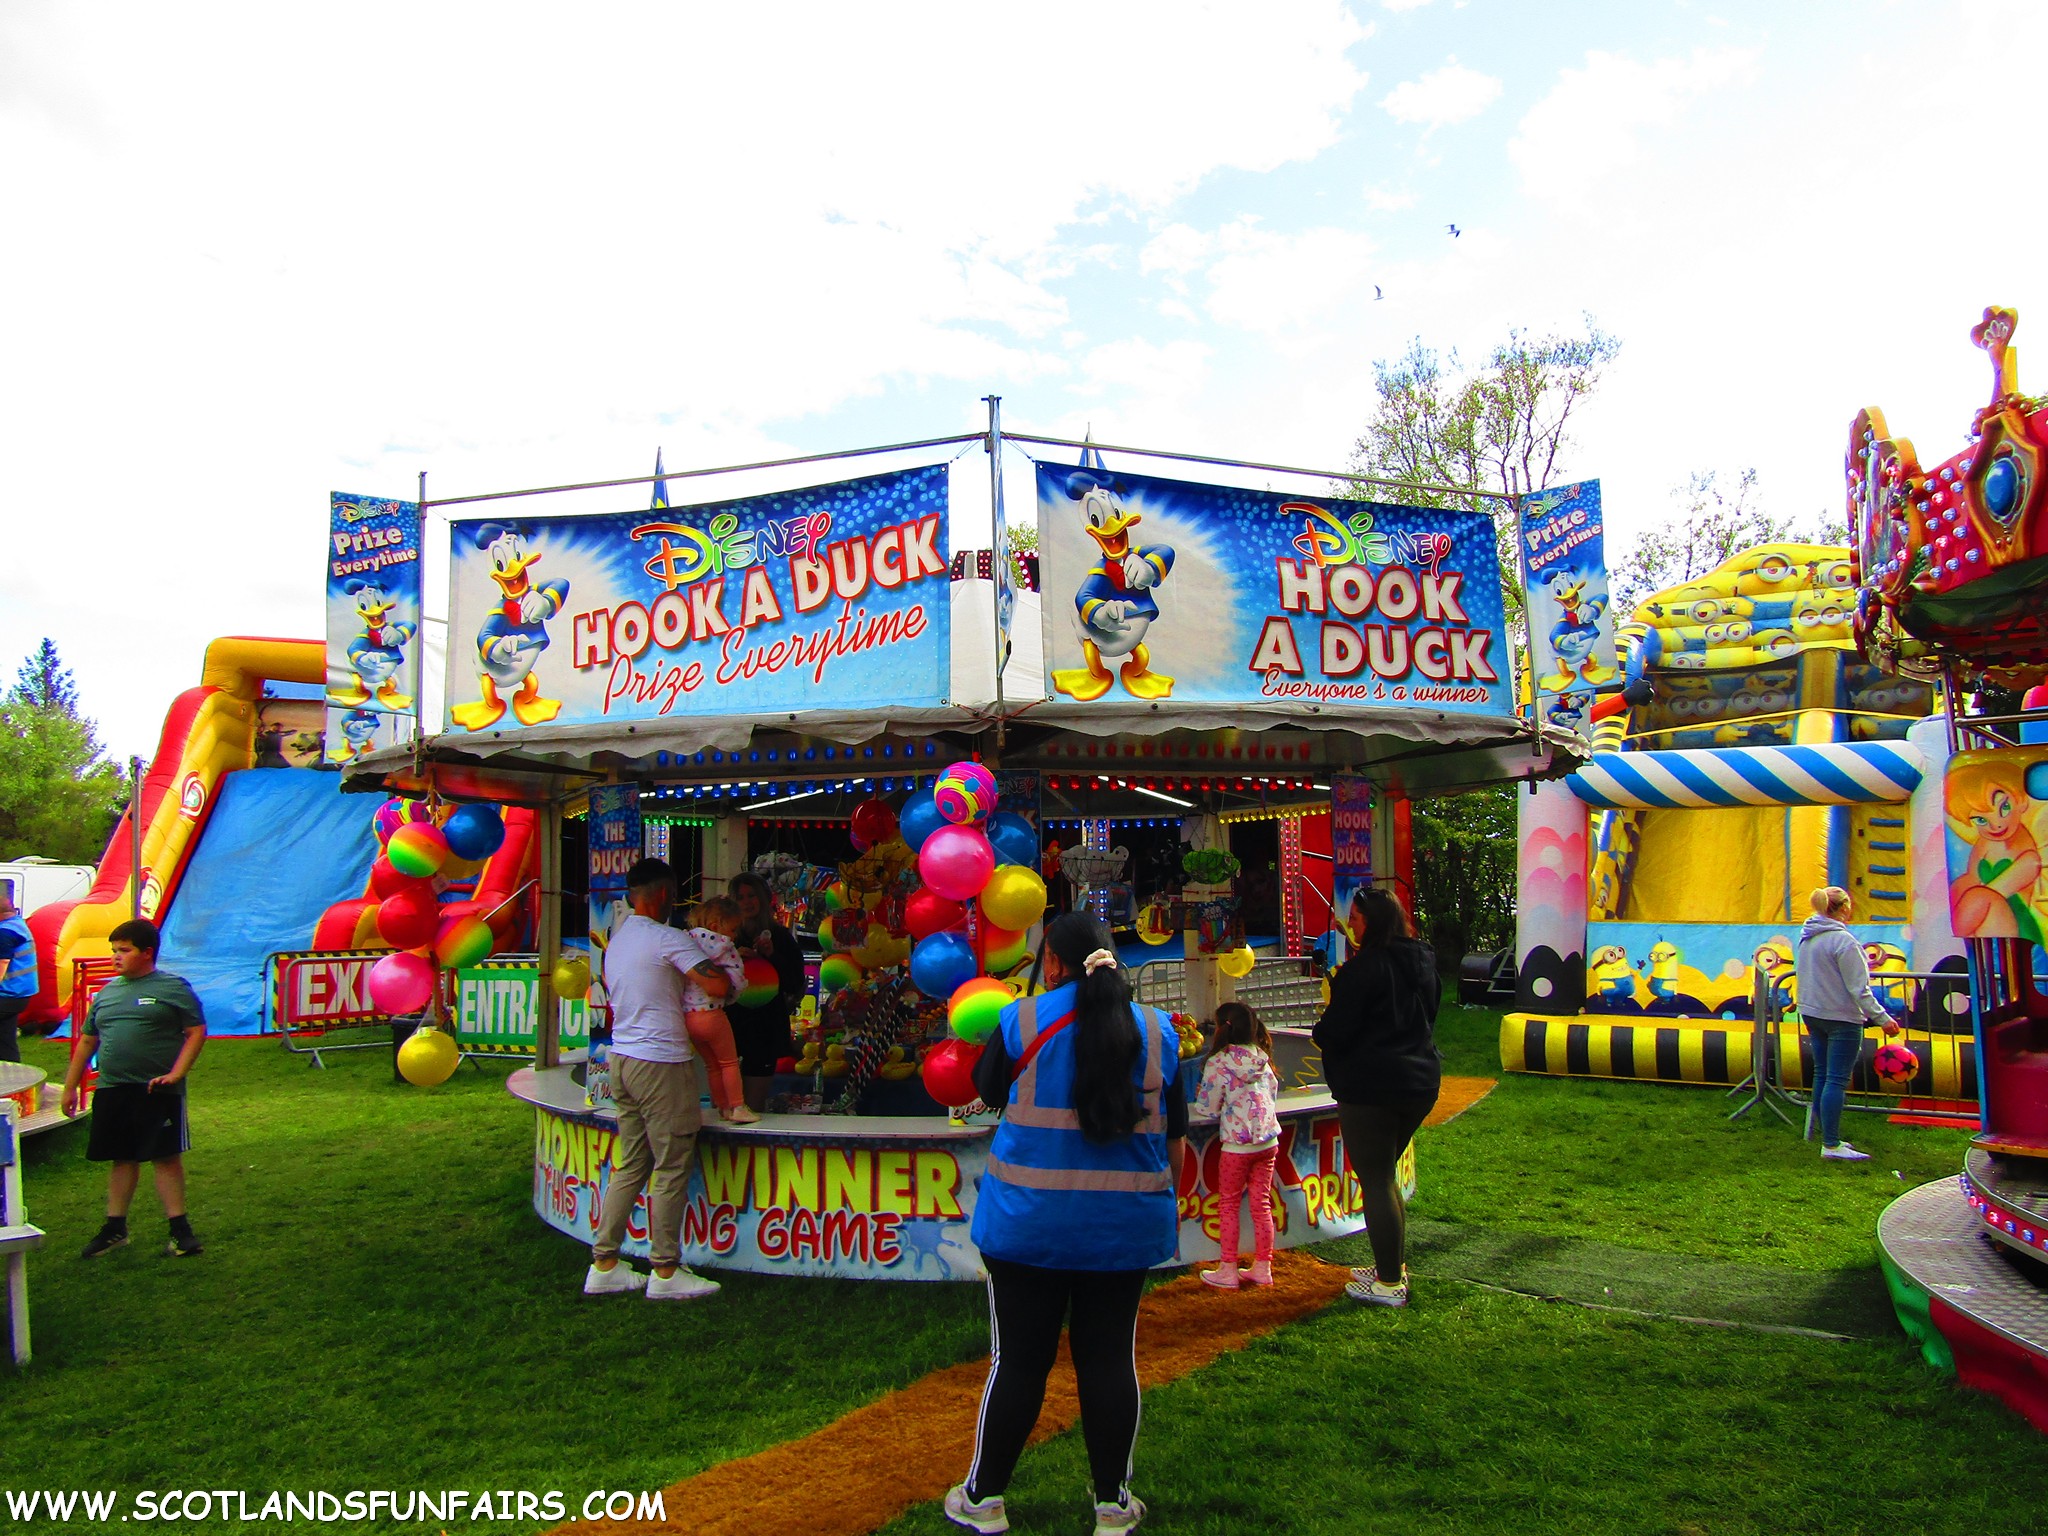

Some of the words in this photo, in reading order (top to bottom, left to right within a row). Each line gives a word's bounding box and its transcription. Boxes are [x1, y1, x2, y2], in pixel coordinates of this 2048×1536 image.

[333, 525, 402, 556] Prize
[1525, 508, 1586, 553] Prize
[1527, 524, 1602, 572] Everytime
[332, 548, 418, 577] Everytime
[572, 586, 731, 670] HOOK
[740, 566, 783, 630] A
[793, 513, 947, 612] DUCK
[1277, 558, 1469, 624] HOOK
[602, 653, 704, 715] Prize
[715, 603, 929, 683] Everytime
[1249, 614, 1303, 674] A
[1319, 620, 1498, 682] DUCK
[1261, 669, 1384, 702] Everyone's
[1392, 684, 1408, 701] a
[1413, 682, 1489, 705] winner
[603, 821, 626, 842] THE
[1334, 811, 1370, 830] HOOK
[1336, 844, 1369, 866] DUCK
[297, 961, 374, 1018] EXI
[700, 1142, 965, 1218] WINNER
[1302, 1170, 1364, 1226] PRIZ
[543, 1162, 579, 1222] THIS
[756, 1206, 903, 1267] GAME
